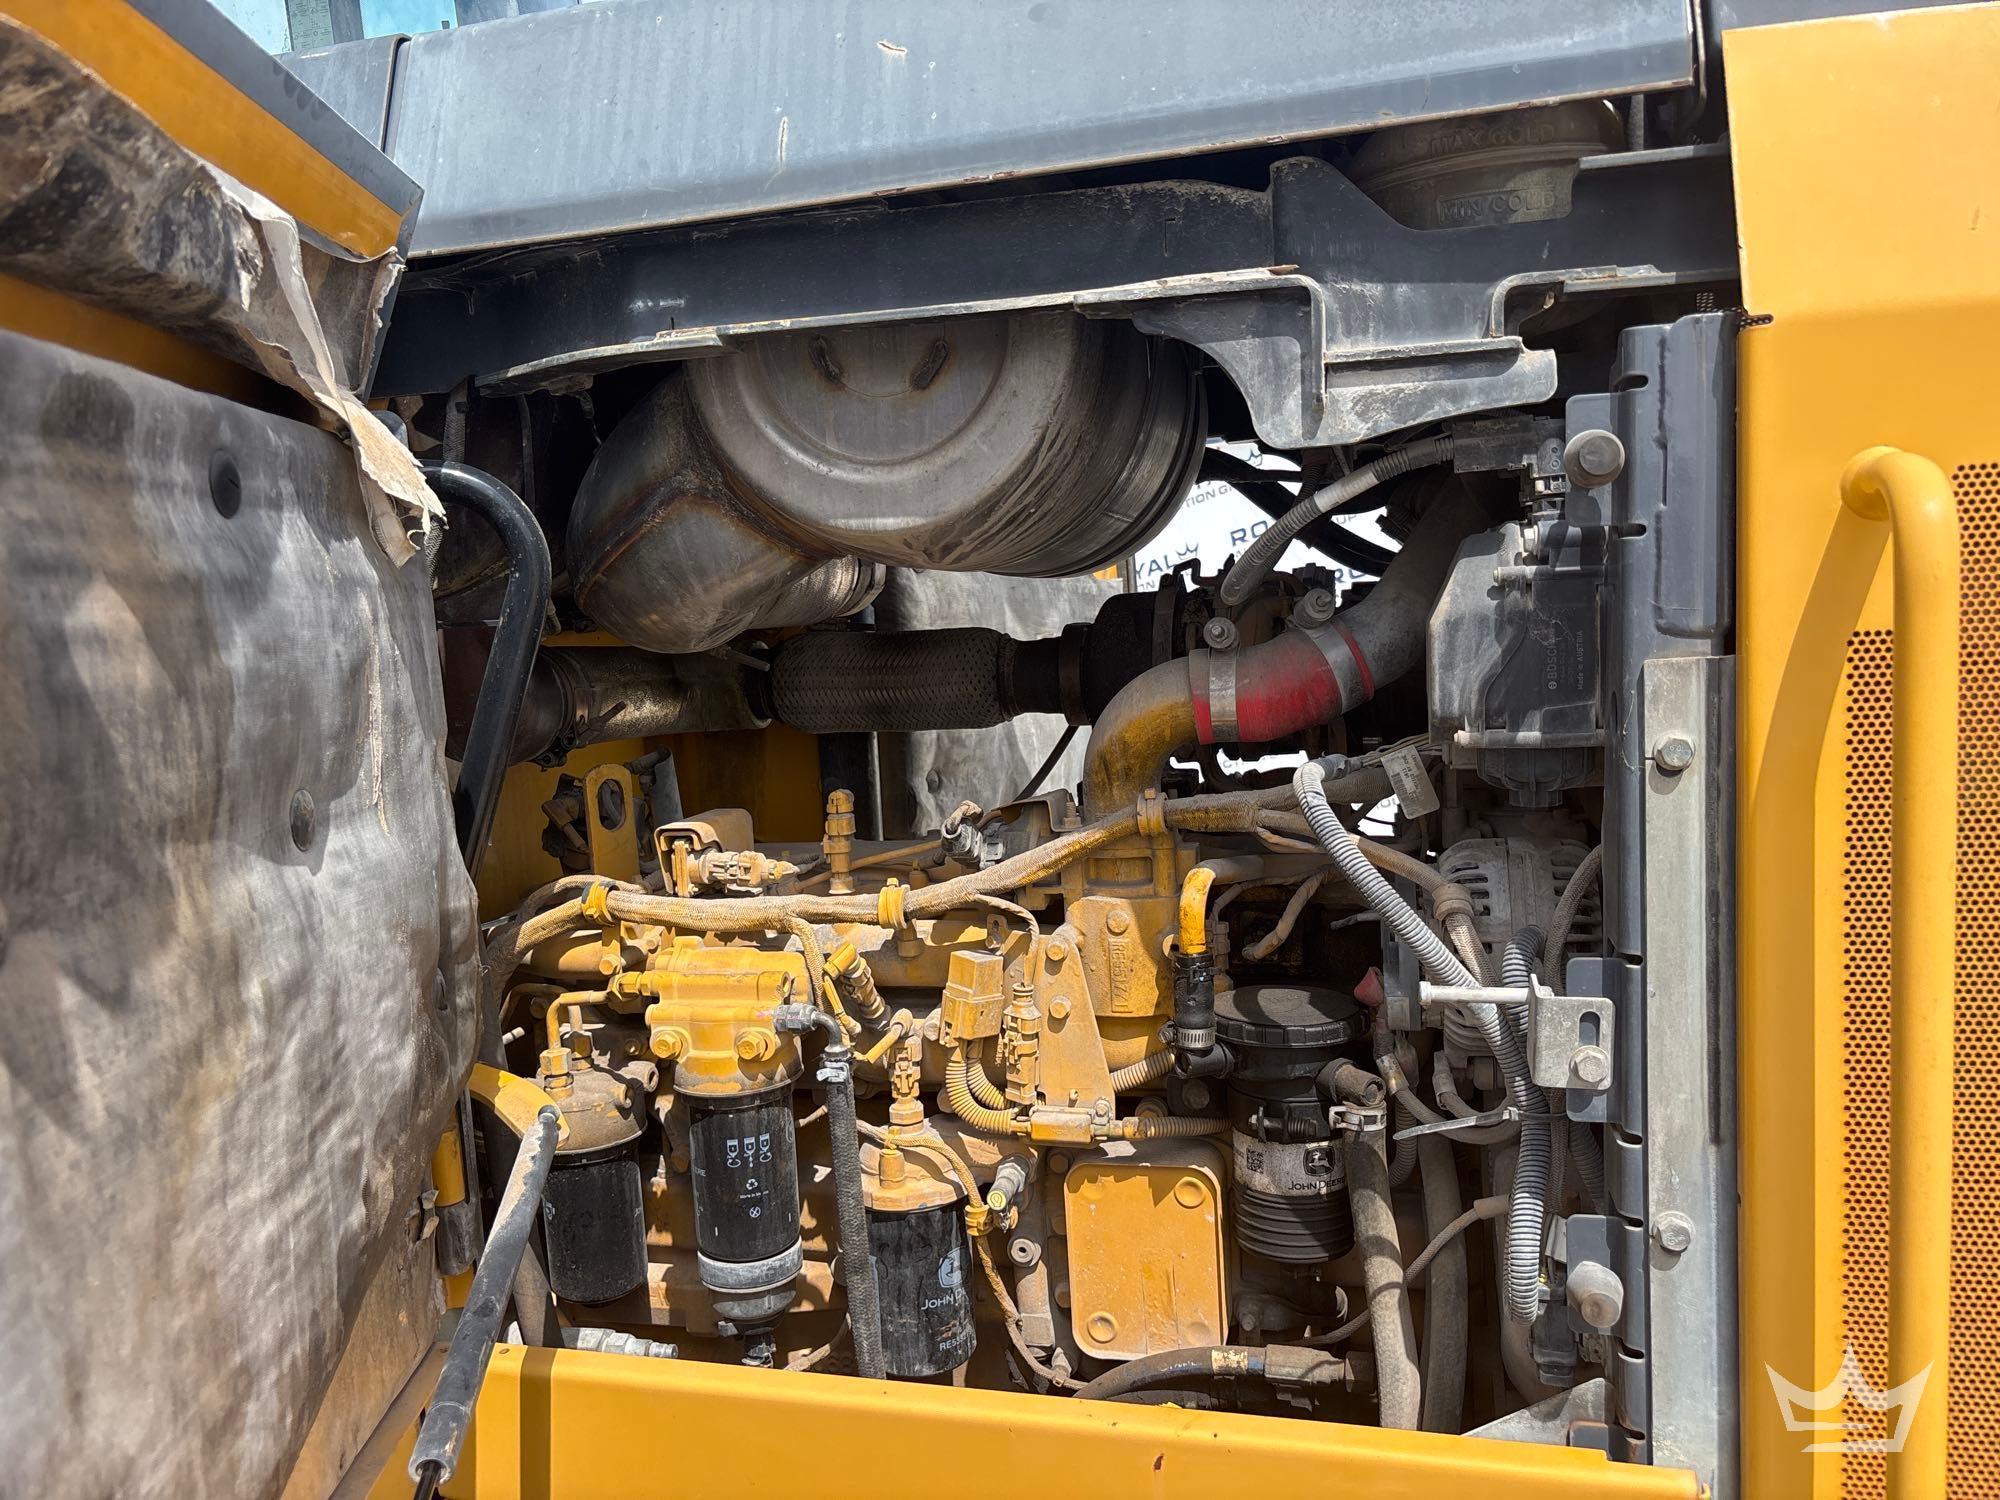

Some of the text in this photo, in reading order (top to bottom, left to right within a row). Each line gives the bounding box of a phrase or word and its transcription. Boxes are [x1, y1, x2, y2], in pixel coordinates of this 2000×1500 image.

[1431, 123, 1555, 153] MAX COLD
[1438, 188, 1556, 221] MIN COLD
[1136, 554, 1175, 579] YAL
[1288, 1180, 1317, 1191] JOHN
[921, 1293, 954, 1310] JOHN
